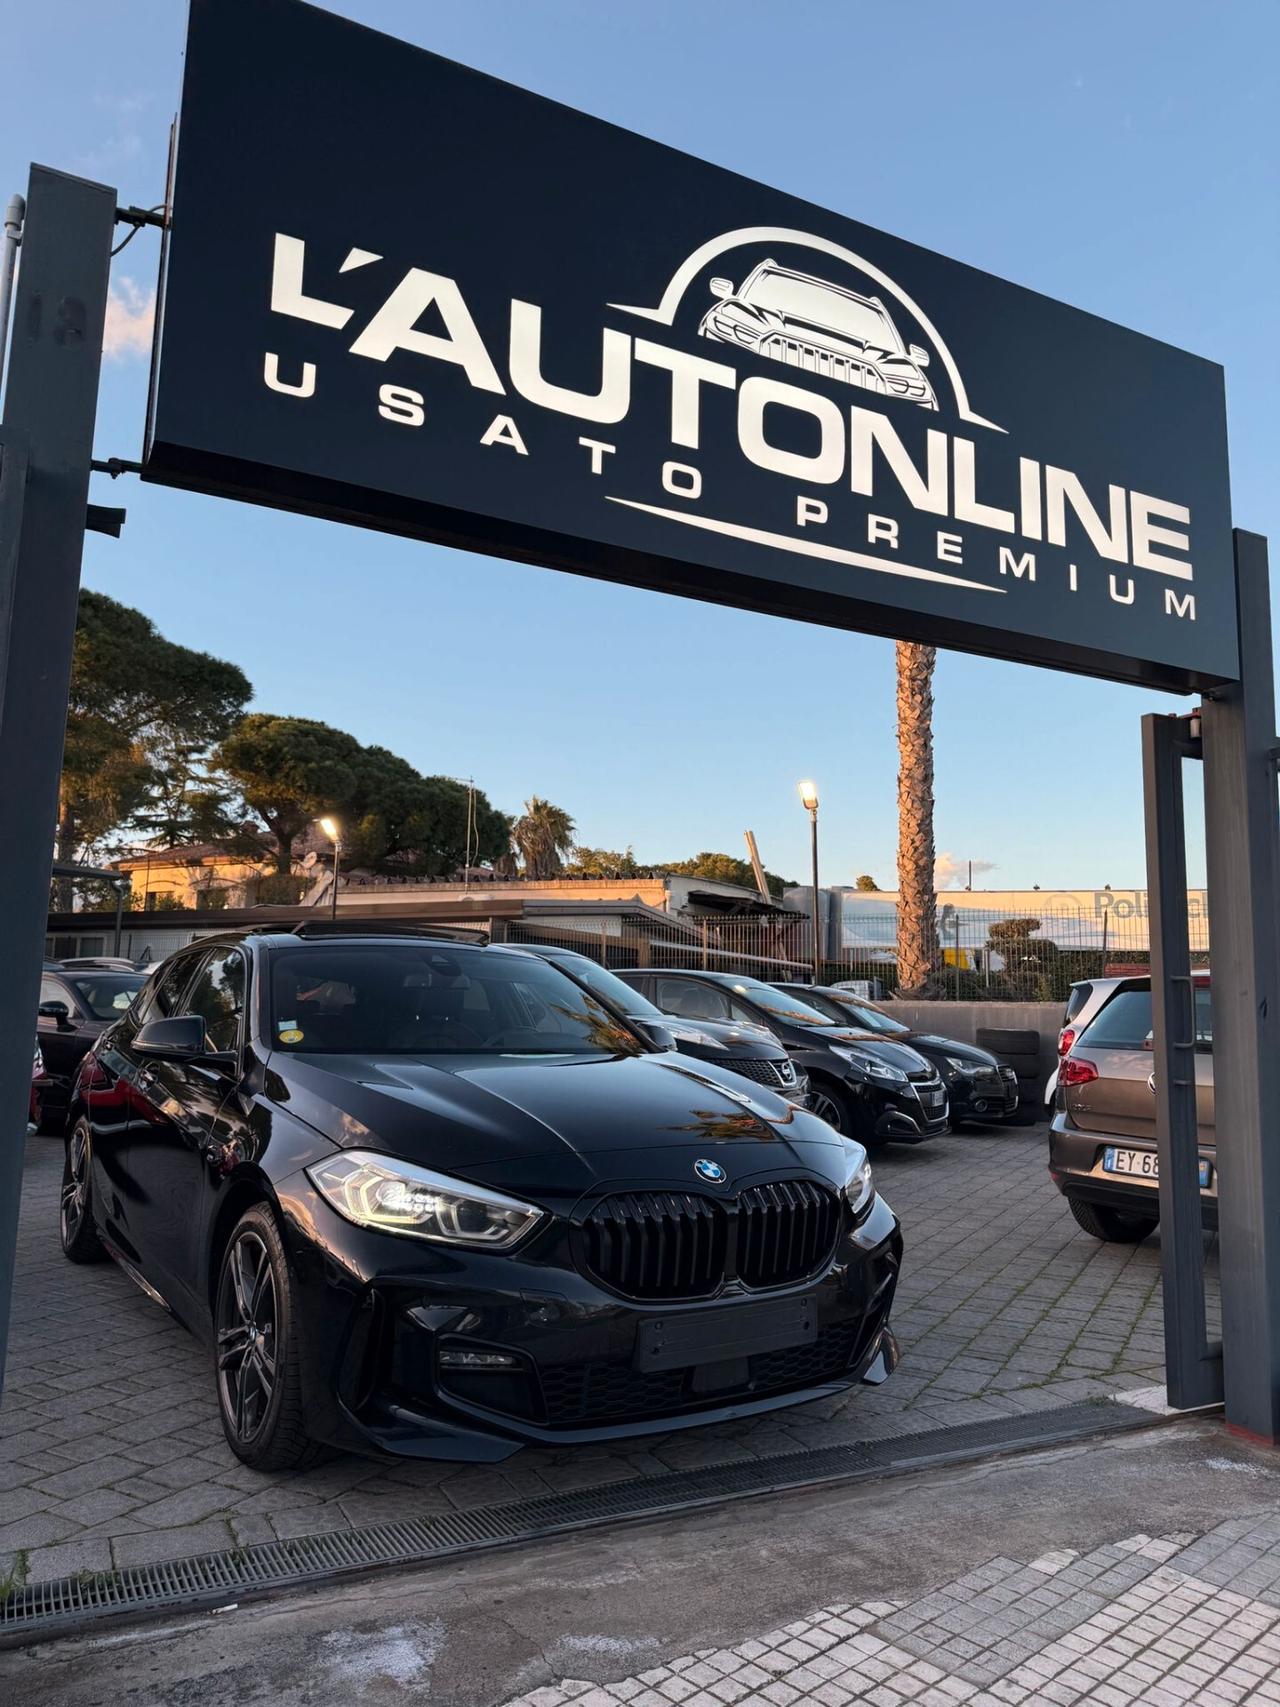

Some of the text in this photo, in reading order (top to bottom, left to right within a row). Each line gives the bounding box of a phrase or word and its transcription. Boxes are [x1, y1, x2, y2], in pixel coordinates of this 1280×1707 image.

[263, 352, 1196, 621] USATO PREMIUM
[1116, 1151, 1159, 1175] EY 68
